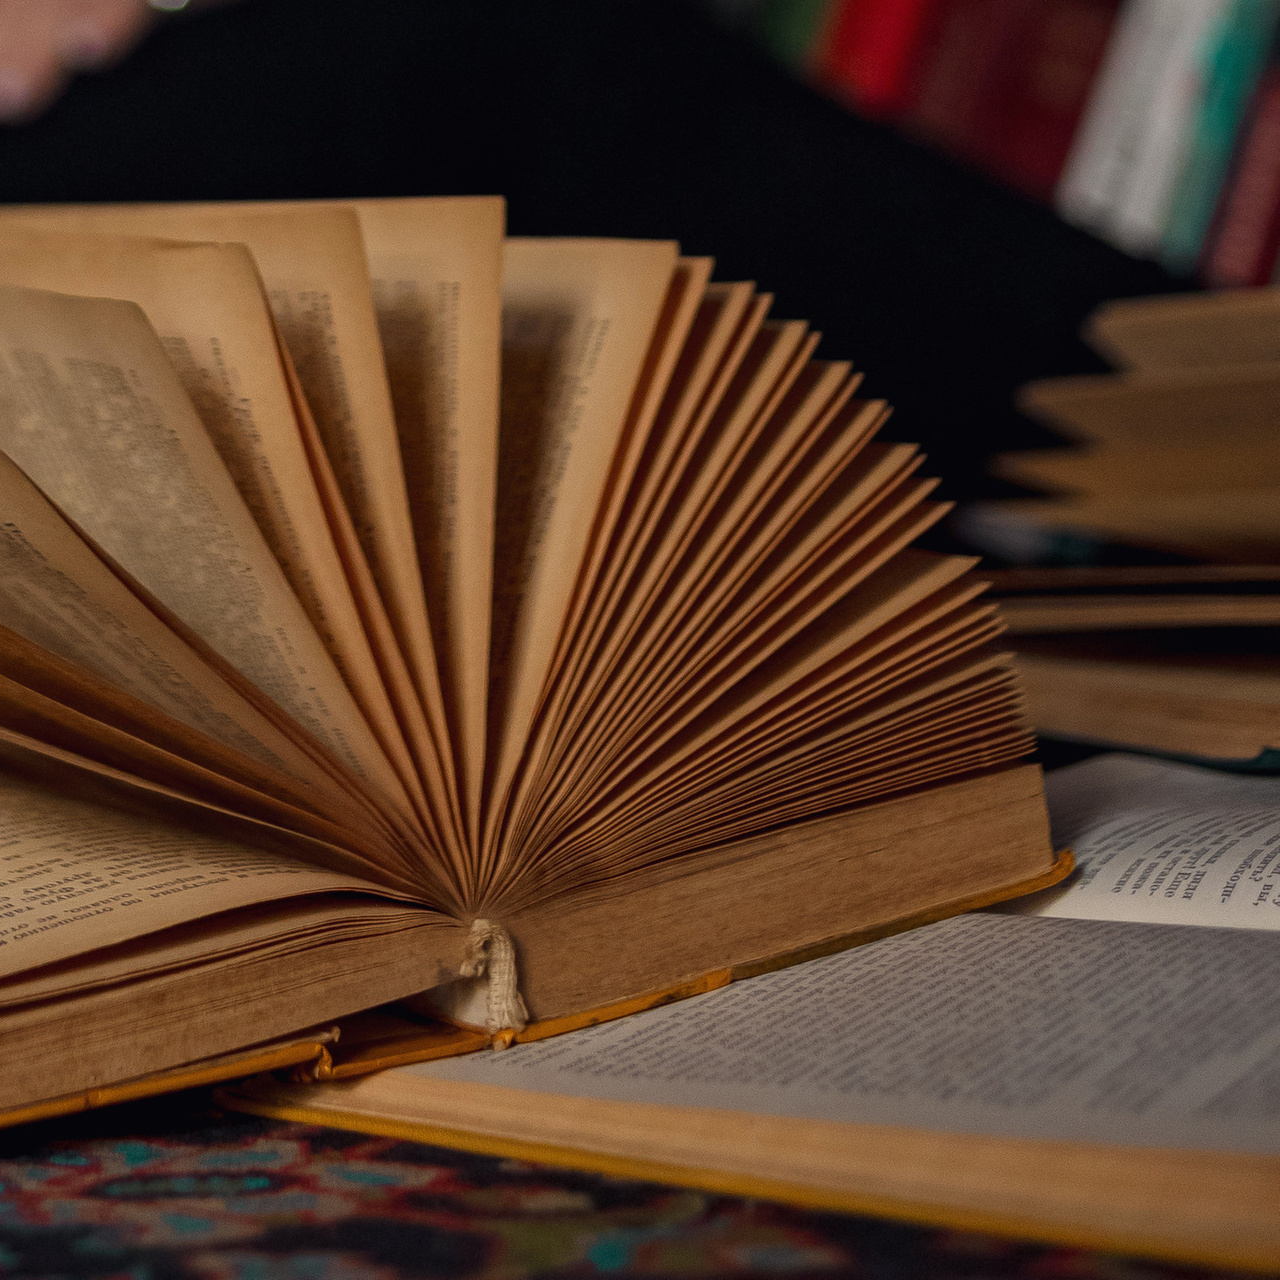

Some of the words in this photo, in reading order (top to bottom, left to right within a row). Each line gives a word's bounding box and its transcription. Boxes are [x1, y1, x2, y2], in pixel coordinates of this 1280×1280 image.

[18, 869, 96, 895] другому
[38, 878, 121, 906] ужасную
[1164, 872, 1192, 898] Еще
[1252, 883, 1274, 907] вы,
[61, 891, 134, 915] однако,
